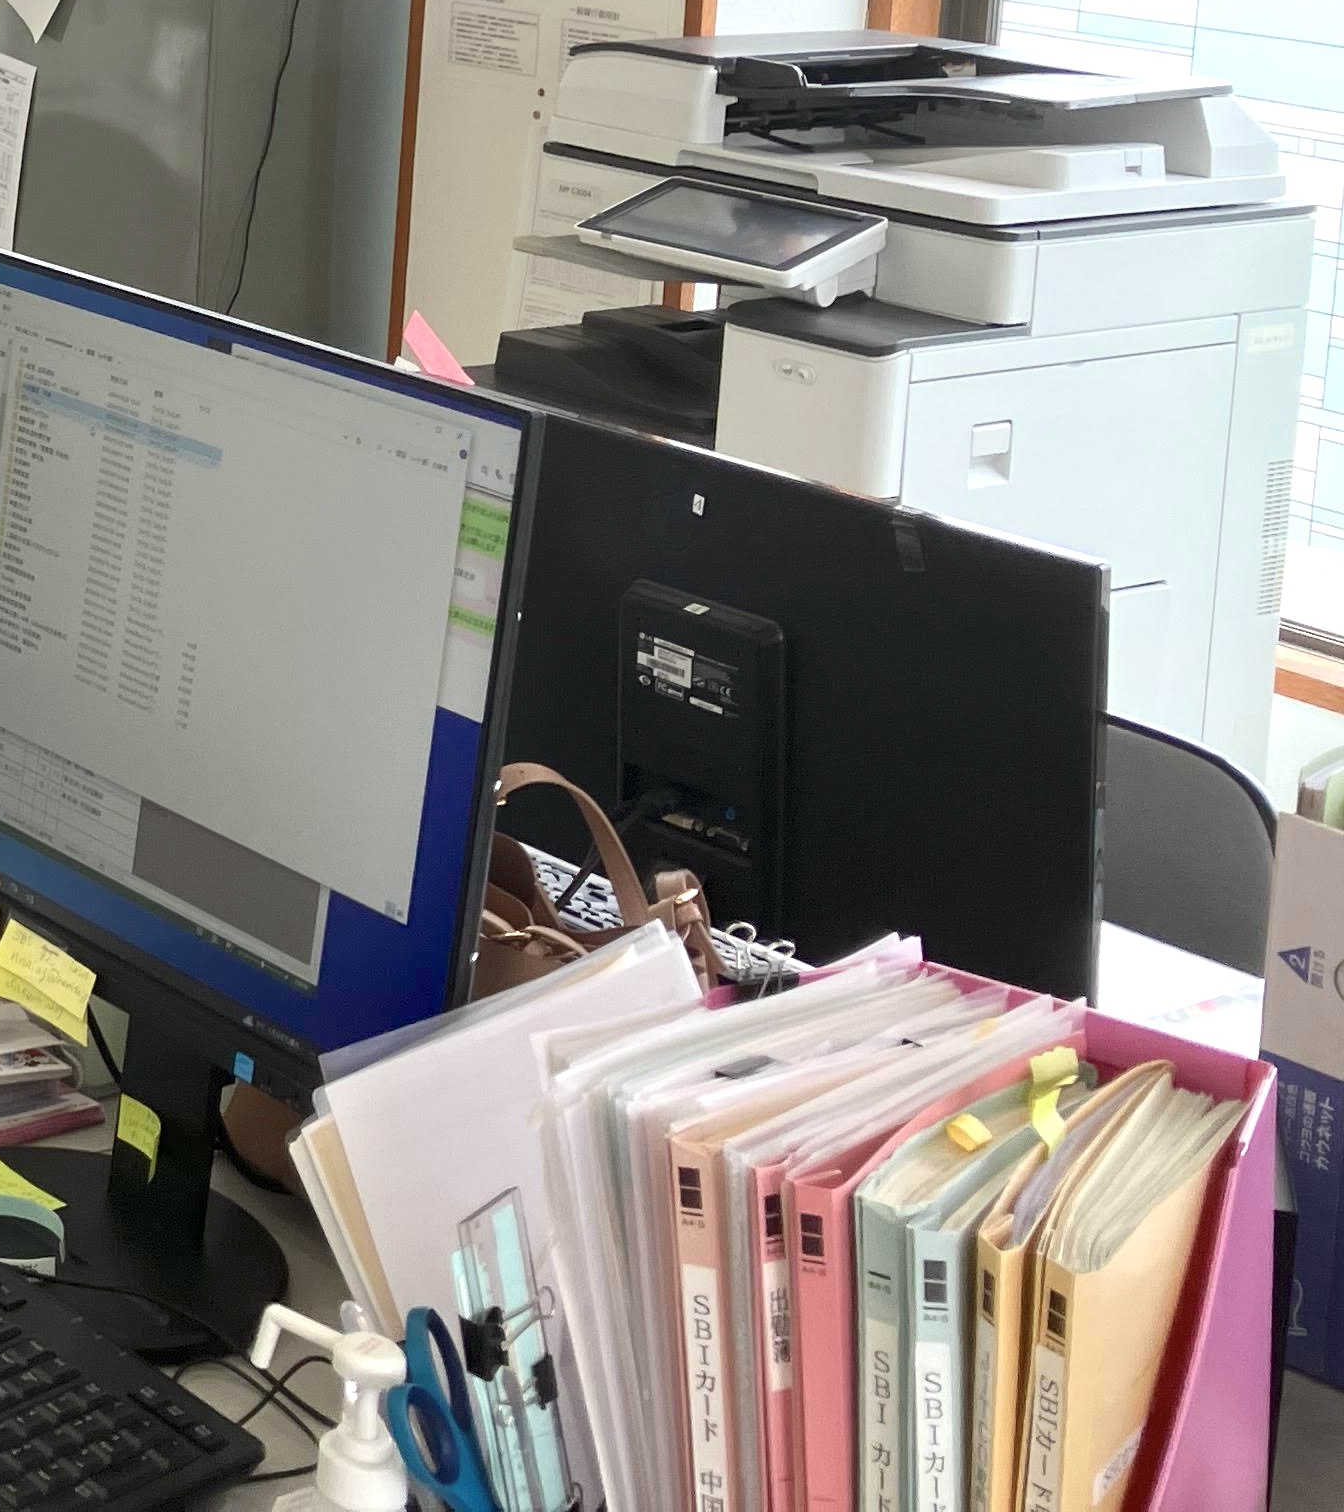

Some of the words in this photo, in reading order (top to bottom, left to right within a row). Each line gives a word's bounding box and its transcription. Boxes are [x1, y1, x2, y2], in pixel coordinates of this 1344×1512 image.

[1288, 953, 1306, 970] 2
[1315, 1096, 1336, 1171] カウネット
[693, 1294, 719, 1442] SBIカード
[873, 1350, 891, 1425] SBI
[1031, 1374, 1060, 1512] SBIカード
